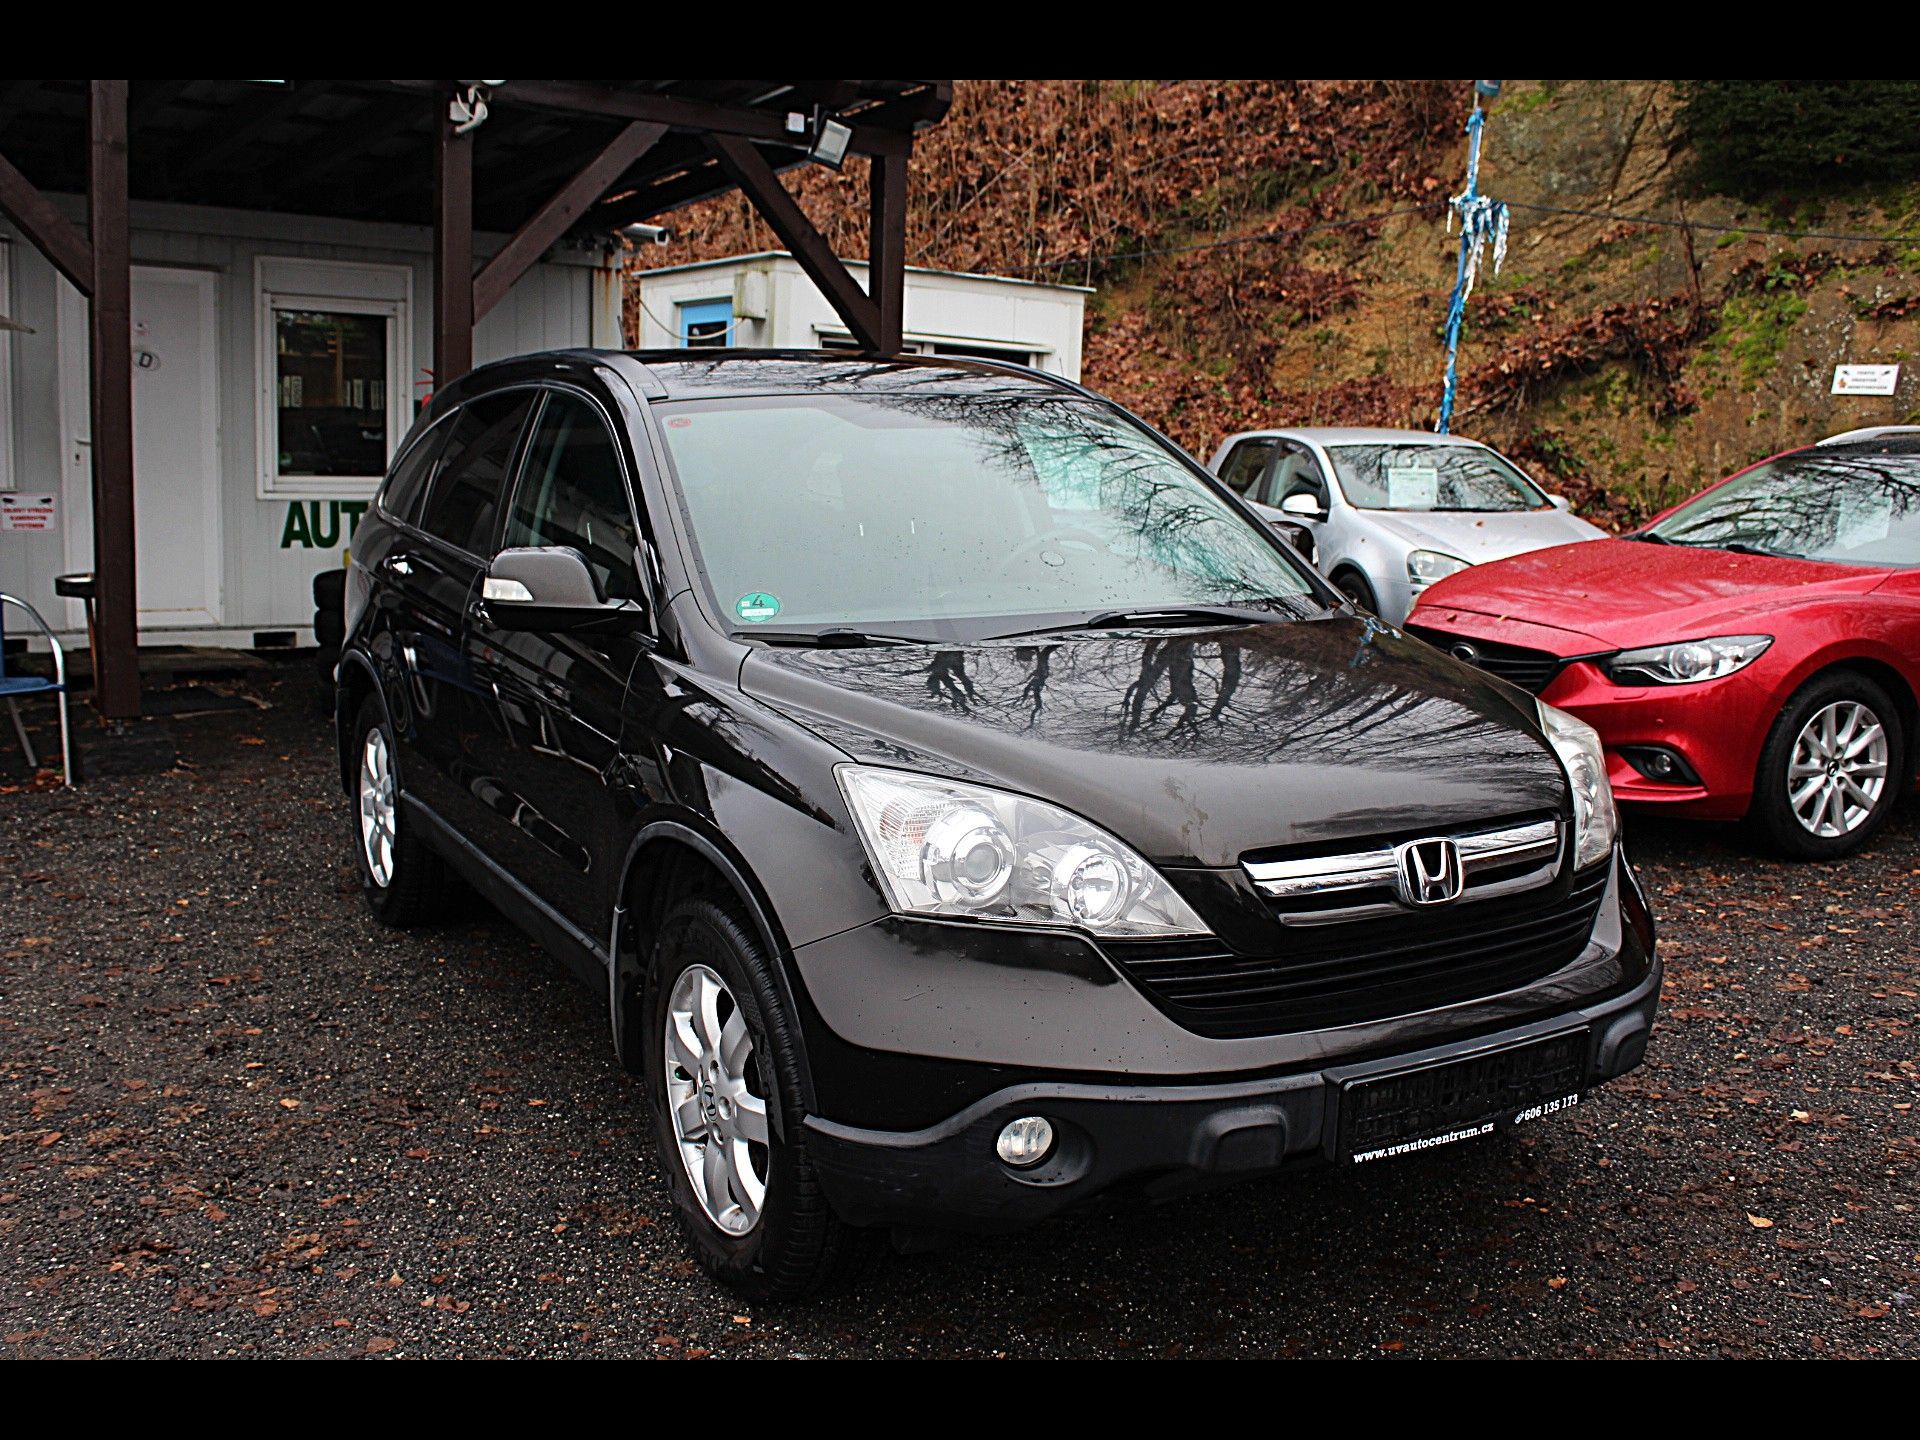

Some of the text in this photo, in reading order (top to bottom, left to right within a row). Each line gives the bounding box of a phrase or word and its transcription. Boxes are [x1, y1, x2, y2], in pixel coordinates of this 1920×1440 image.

[752, 595, 765, 607] 4
[1524, 1094, 1578, 1121] 606 135 173
[1353, 1121, 1494, 1164] www.uvautocentrum.cz
